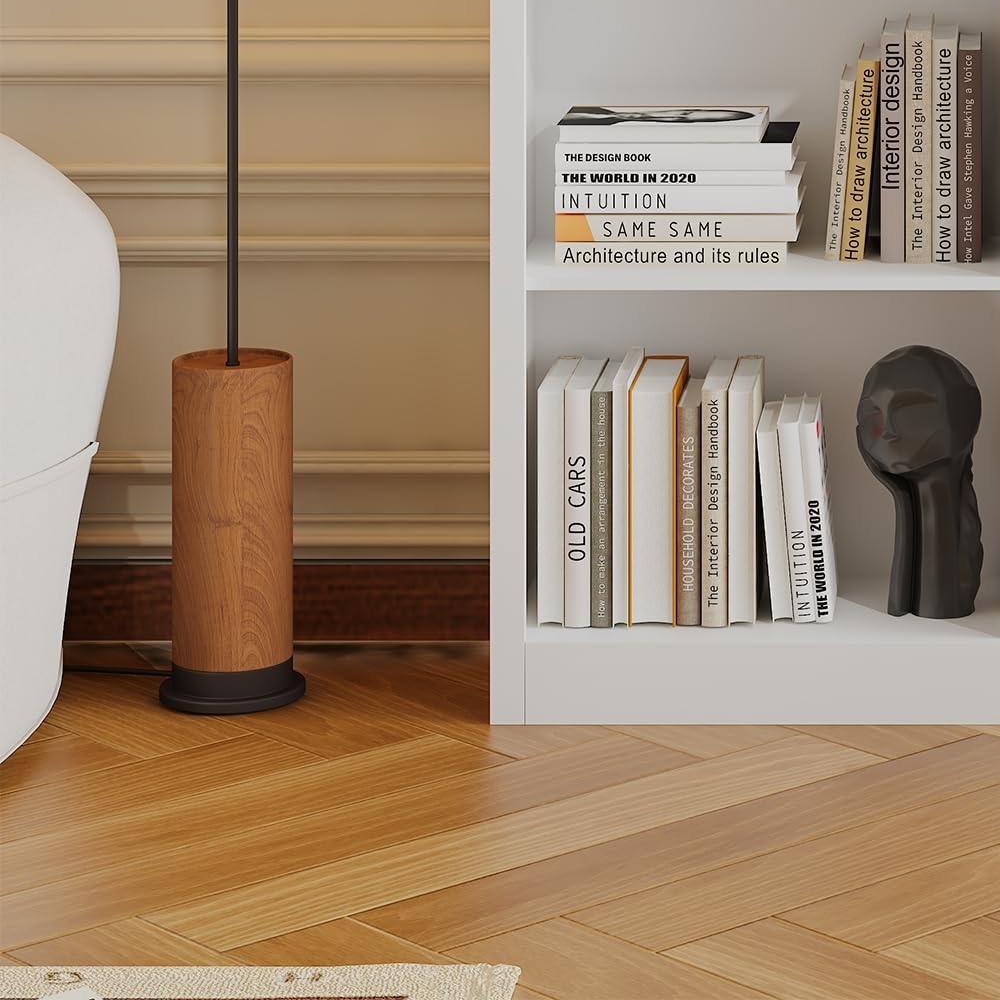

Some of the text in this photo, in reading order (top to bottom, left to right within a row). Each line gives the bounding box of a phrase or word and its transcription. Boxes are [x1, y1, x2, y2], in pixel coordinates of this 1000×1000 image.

[963, 55, 973, 83] Voice
[882, 44, 904, 189] Interior design
[911, 40, 927, 251] The Interior Design Handbook
[963, 98, 975, 138] Hawking
[562, 173, 697, 183] THE WORLD IN 2020
[564, 153, 652, 162] THE DESIGN BOOK
[829, 88, 850, 251] The Interior Design Handbook
[844, 68, 874, 260] How to draw architecture
[936, 49, 951, 262] How to draw architecture
[963, 142, 974, 182] Stephen
[563, 194, 665, 209] INTUITION
[604, 222, 722, 237] SAME SAME
[963, 187, 973, 210] Gave
[963, 215, 973, 242] Intel
[563, 248, 779, 263] Architecture and its rules
[568, 456, 585, 561] OLD CARS
[682, 437, 696, 592] HOUSEHOLD DECORATES
[706, 399, 722, 608] The Interior Design Handbook
[791, 530, 811, 617] INTUITION
[808, 500, 829, 617] THE WORLD IN 2020
